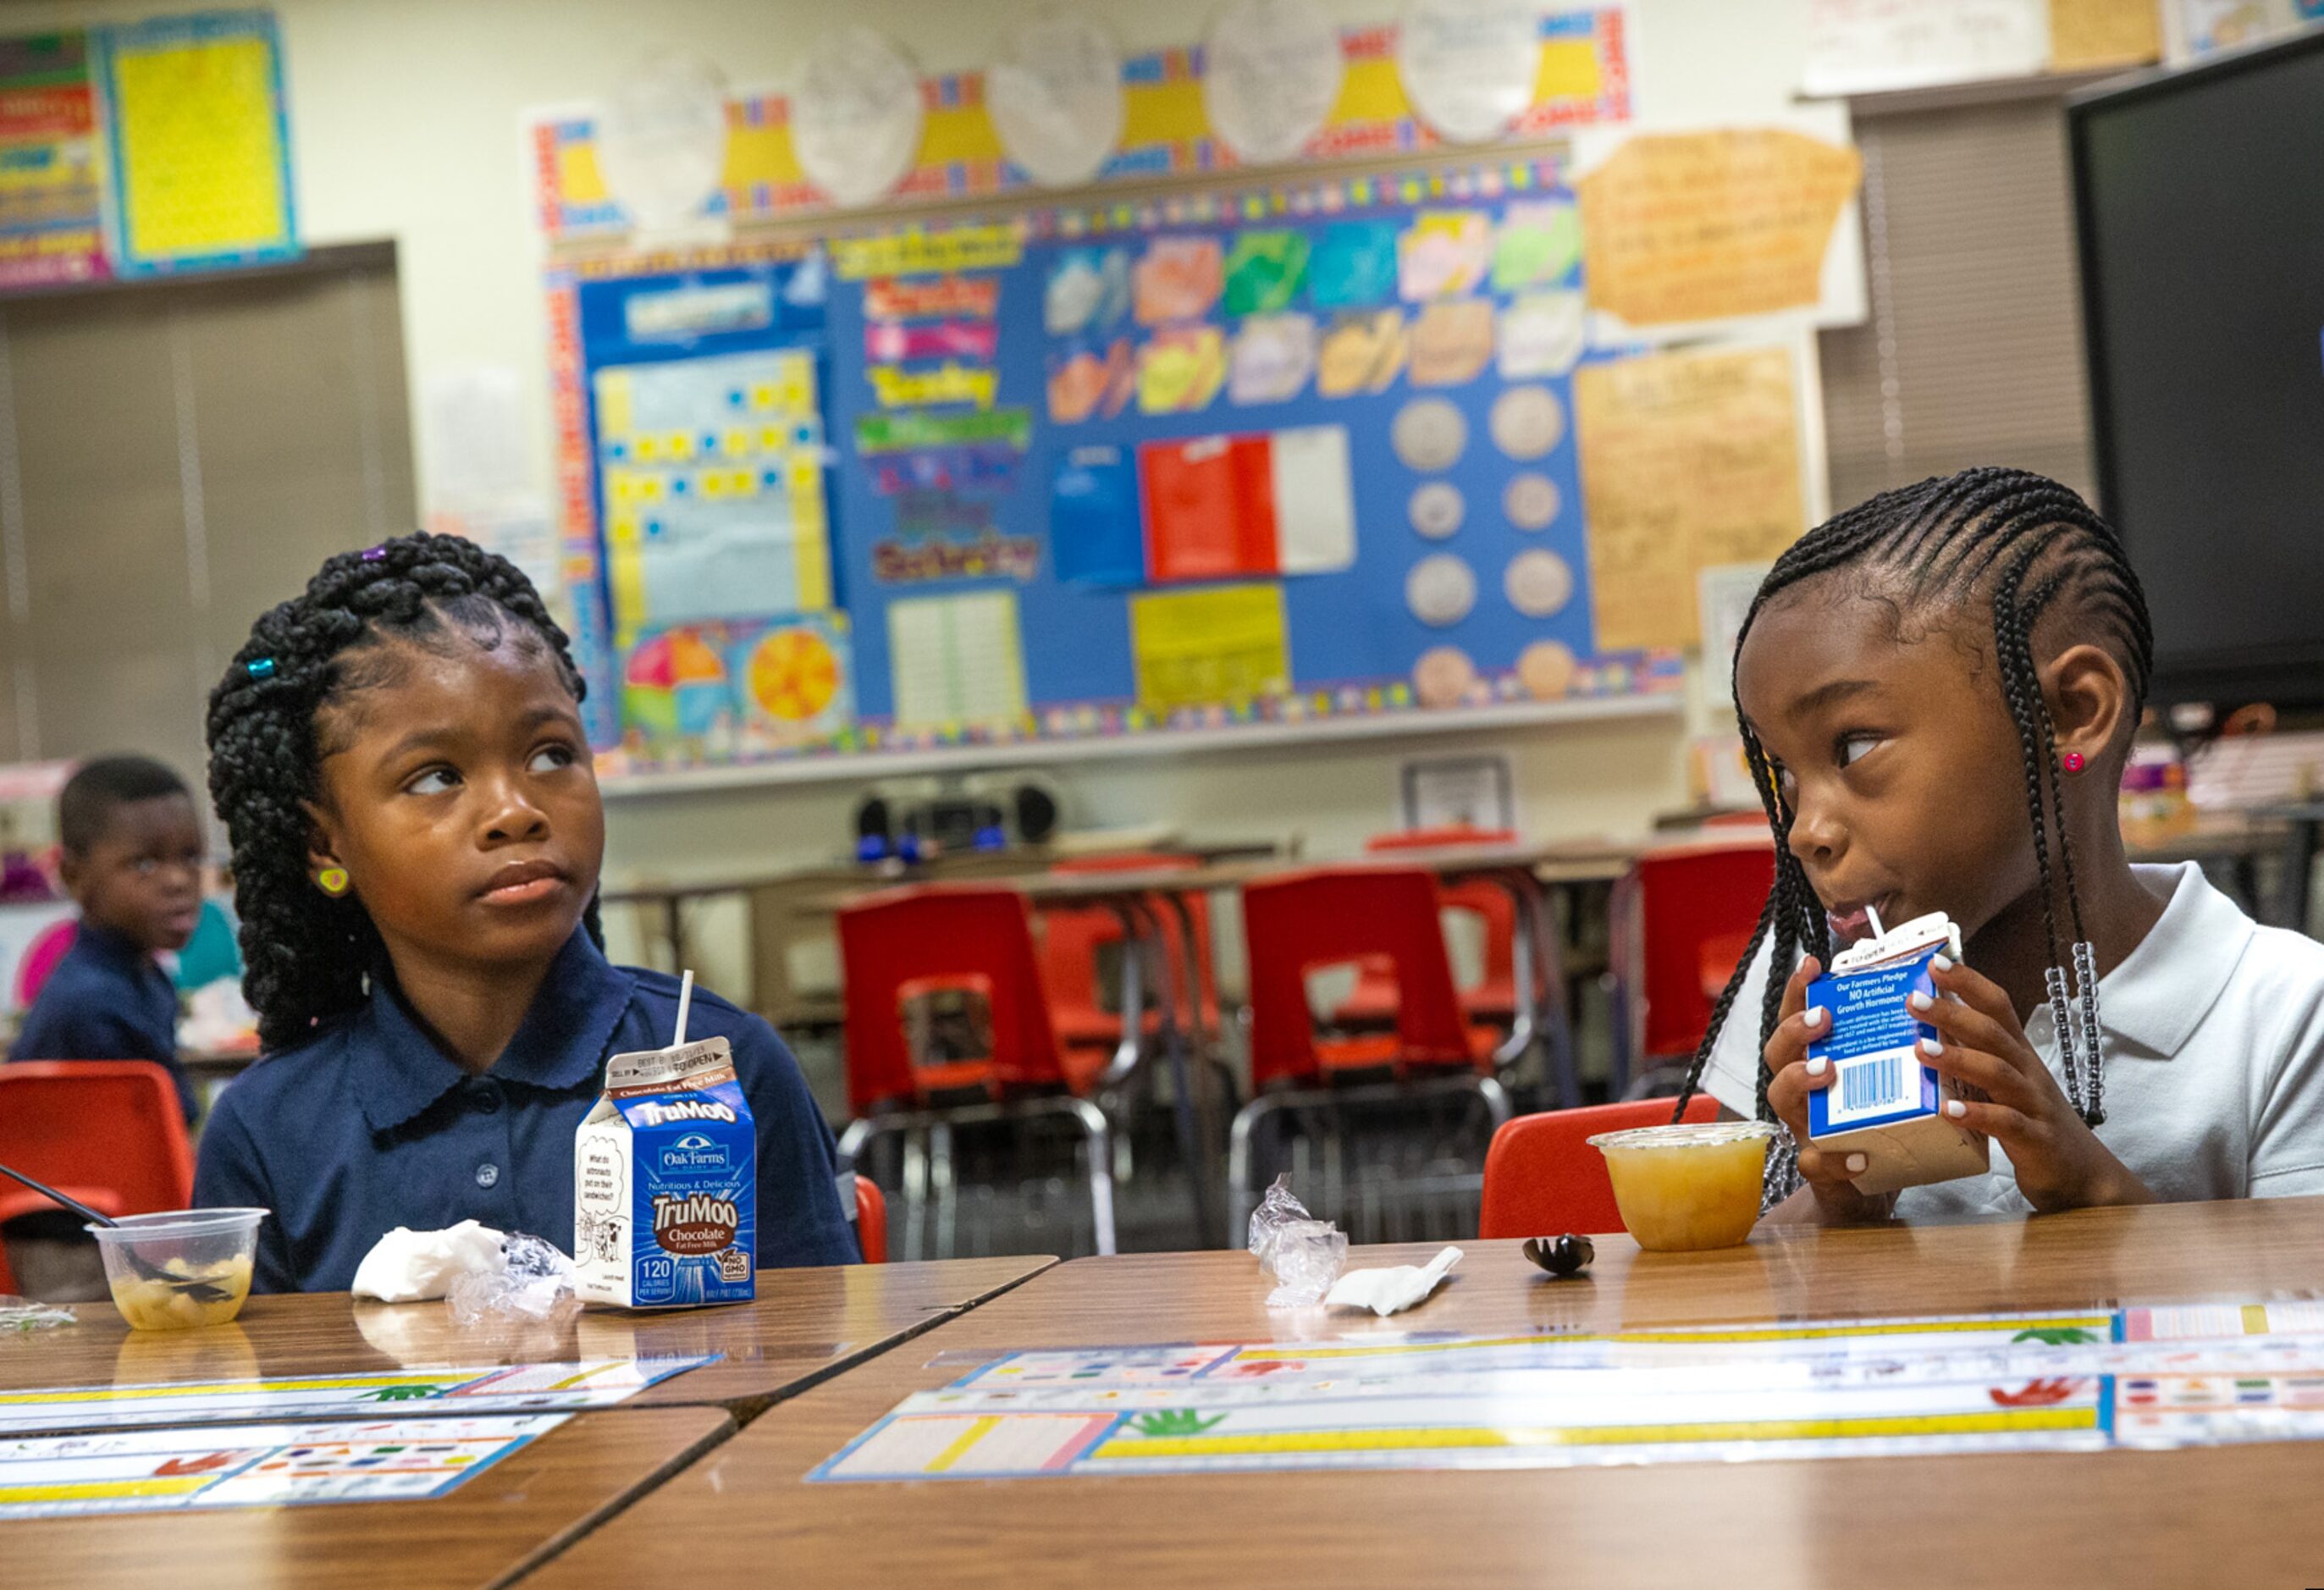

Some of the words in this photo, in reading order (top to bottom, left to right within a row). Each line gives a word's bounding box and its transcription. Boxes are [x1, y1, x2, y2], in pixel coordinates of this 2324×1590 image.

[1836, 982, 1850, 992] Our
[1851, 978, 1881, 990] Farmers
[1882, 972, 1908, 983] Pledge
[1849, 990, 1863, 1002] NO
[1863, 984, 1895, 998] Artificial
[1836, 1001, 1865, 1014] Growth
[673, 1062, 686, 1072] TO
[687, 1052, 713, 1068] OPEN
[620, 1085, 666, 1097] Chocolate
[666, 1084, 682, 1093] Fat
[703, 1072, 726, 1084] Milk
[634, 1101, 737, 1128] TruMoo
[589, 1155, 601, 1163] What
[664, 1152, 687, 1167] Oak
[689, 1151, 726, 1165] Farms
[648, 1182, 691, 1190] Nutritious
[703, 1179, 740, 1189] Delicious
[653, 1195, 737, 1231] TruMoo
[668, 1228, 726, 1242] Chocolate
[643, 1260, 671, 1278] 120
[725, 1264, 746, 1273] GMO
[728, 1256, 742, 1265] NO
